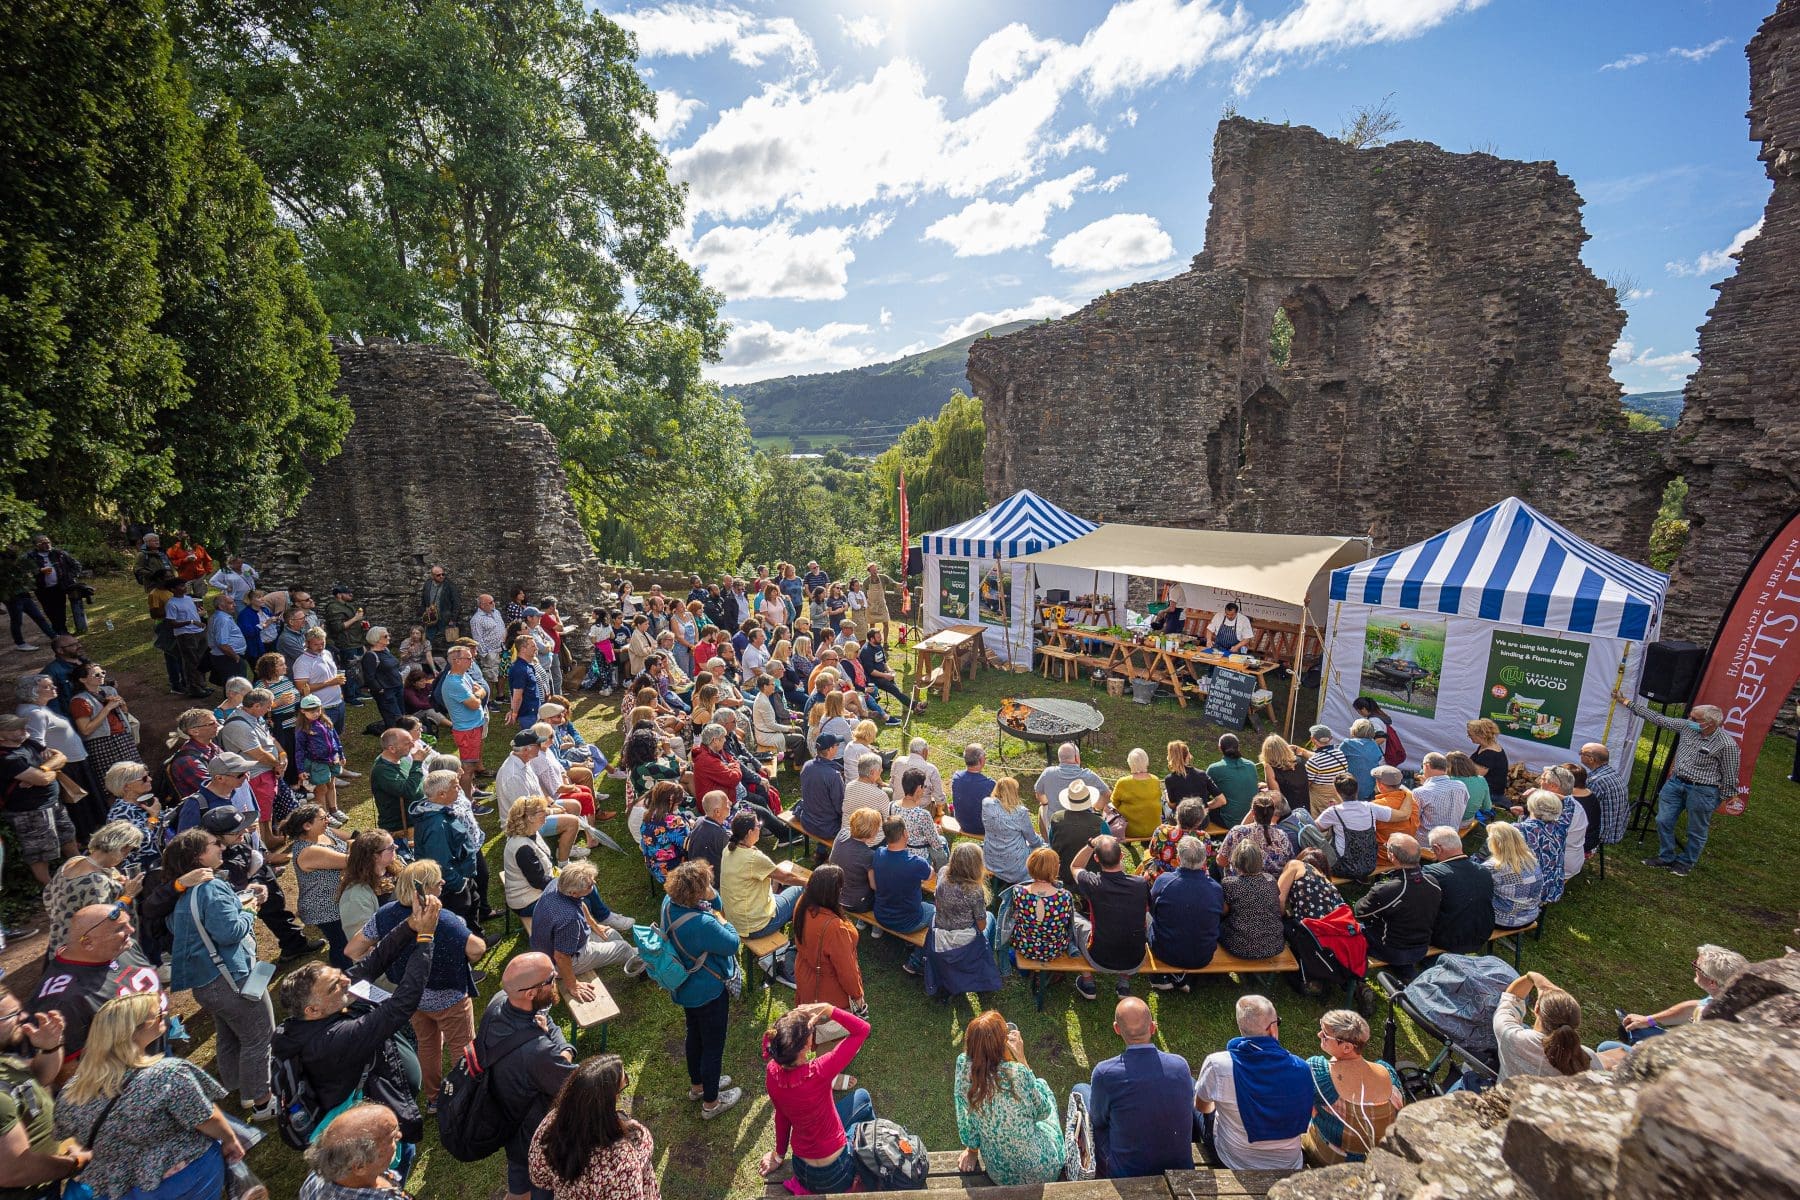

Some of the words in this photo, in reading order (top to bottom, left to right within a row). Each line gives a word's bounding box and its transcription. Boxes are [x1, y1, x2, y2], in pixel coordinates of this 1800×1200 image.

[1727, 608, 1761, 677] HANDMADE
[1757, 591, 1770, 606] IN
[1766, 539, 1799, 588] BRITAIN
[1520, 643, 1535, 651] using
[1550, 647, 1567, 655] dried
[1501, 650, 1524, 660] kindling
[1532, 654, 1557, 664] Flamers
[1558, 659, 1575, 667] from
[1526, 672, 1568, 683] CERTAINLY
[1721, 608, 1799, 742] IREPITS
[1526, 677, 1567, 691] WOOD
[1520, 707, 1536, 715] LOGS
[38, 974, 73, 998] 12
